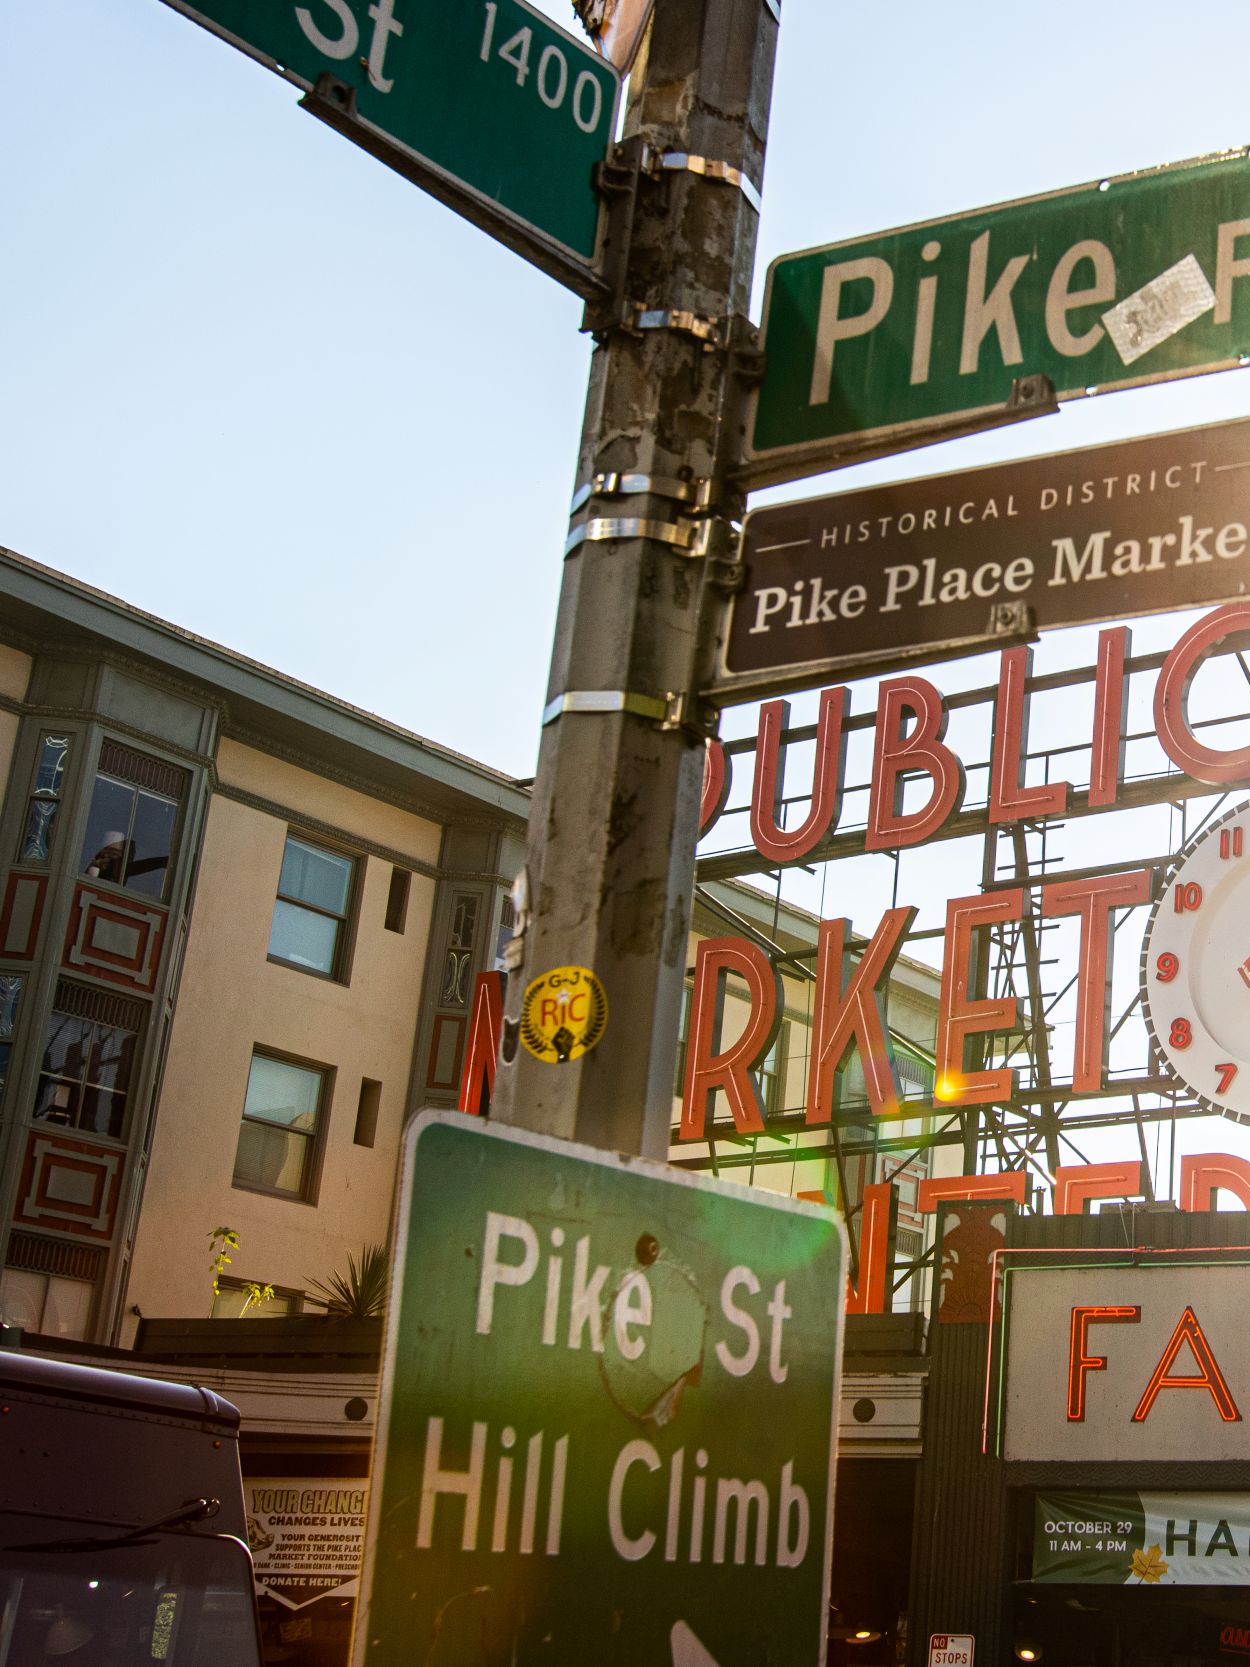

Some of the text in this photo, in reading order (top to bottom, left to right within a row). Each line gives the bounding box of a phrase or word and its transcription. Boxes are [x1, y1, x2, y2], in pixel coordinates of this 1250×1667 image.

[295, 0, 404, 94] St
[478, 1, 603, 134] 1400
[809, 230, 1117, 406] Pike
[821, 461, 1209, 549] HISTORICAL DISTRICT
[748, 578, 867, 635] Pike
[879, 556, 1035, 615] Place
[1219, 826, 1243, 860] 11
[1174, 881, 1203, 914] 10
[548, 971, 580, 988] G-J
[1155, 952, 1180, 983] 9
[458, 869, 1154, 1142] RKET
[1169, 1017, 1193, 1050] 8
[1214, 1062, 1239, 1095] 7
[476, 1211, 653, 1361] Pike
[715, 1265, 793, 1385] St
[252, 1489, 299, 1514] YOUR
[416, 1416, 811, 1569] Hill Climb
[268, 1516, 365, 1527] CHANGES LIVES
[1044, 1521, 1133, 1535] OCTOBER 29
[275, 1543, 311, 1552] SUPPORTS
[312, 1544, 326, 1553] THE
[328, 1544, 342, 1553] PIKE
[281, 1534, 362, 1543] YOUR GENEROSIT
[1049, 1540, 1058, 1552] 11
[1061, 1540, 1081, 1552] AM
[1095, 1540, 1104, 1552] 4
[1106, 1540, 1127, 1552] PM
[268, 1553, 306, 1561] MARKET
[262, 1577, 341, 1587] DONATE HERE!
[933, 1638, 946, 1648] NO
[935, 1652, 968, 1665] STOPS
